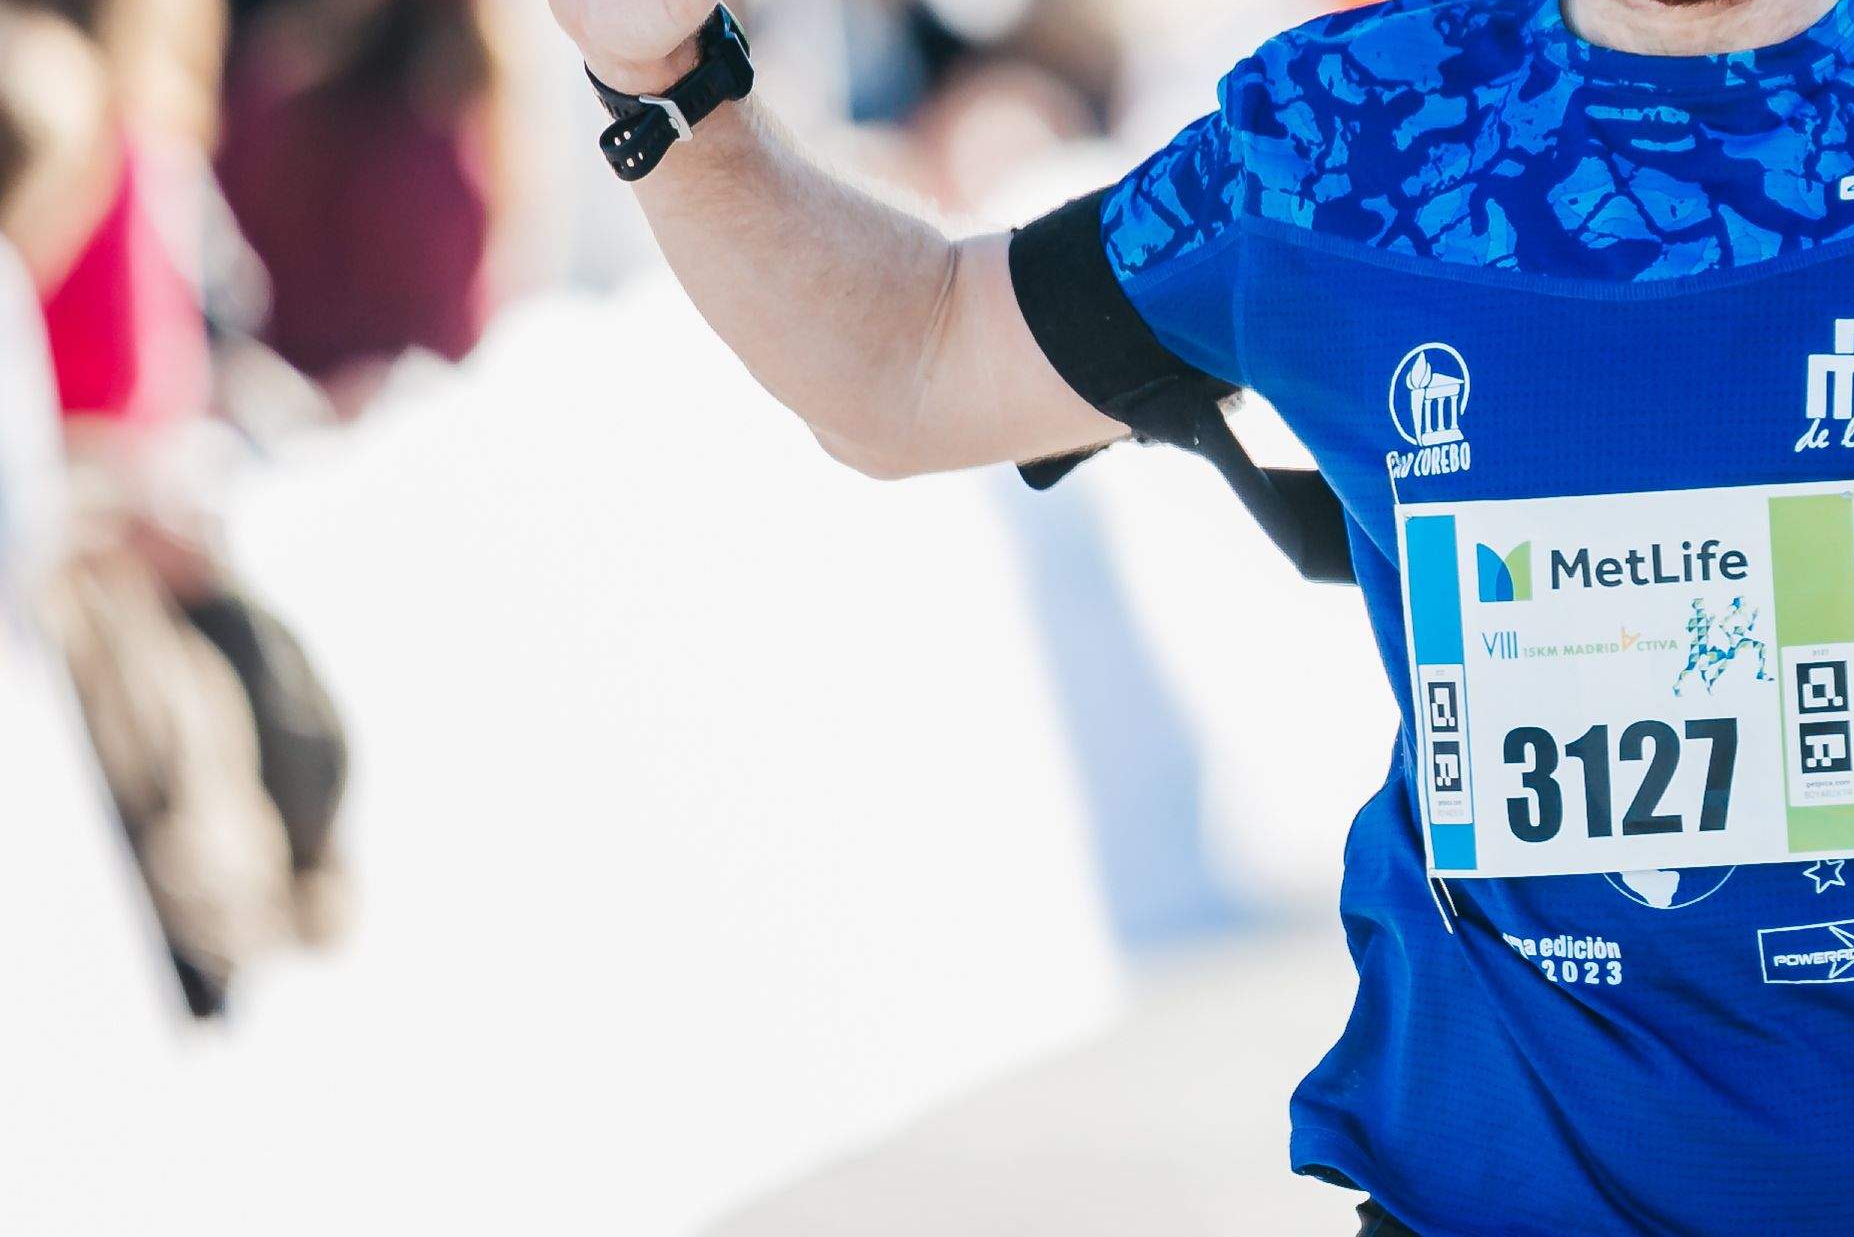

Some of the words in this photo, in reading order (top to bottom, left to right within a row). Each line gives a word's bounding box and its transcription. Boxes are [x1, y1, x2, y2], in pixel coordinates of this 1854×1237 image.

[1795, 418, 1830, 452] de
[1414, 441, 1471, 477] COREBO
[1550, 539, 1749, 590] MetLife
[1482, 631, 1519, 660] VIII
[1523, 644, 1558, 659] 15KM
[1503, 716, 1738, 843] 3127
[1540, 934, 1622, 960] edición
[1541, 959, 1623, 986] 2023
